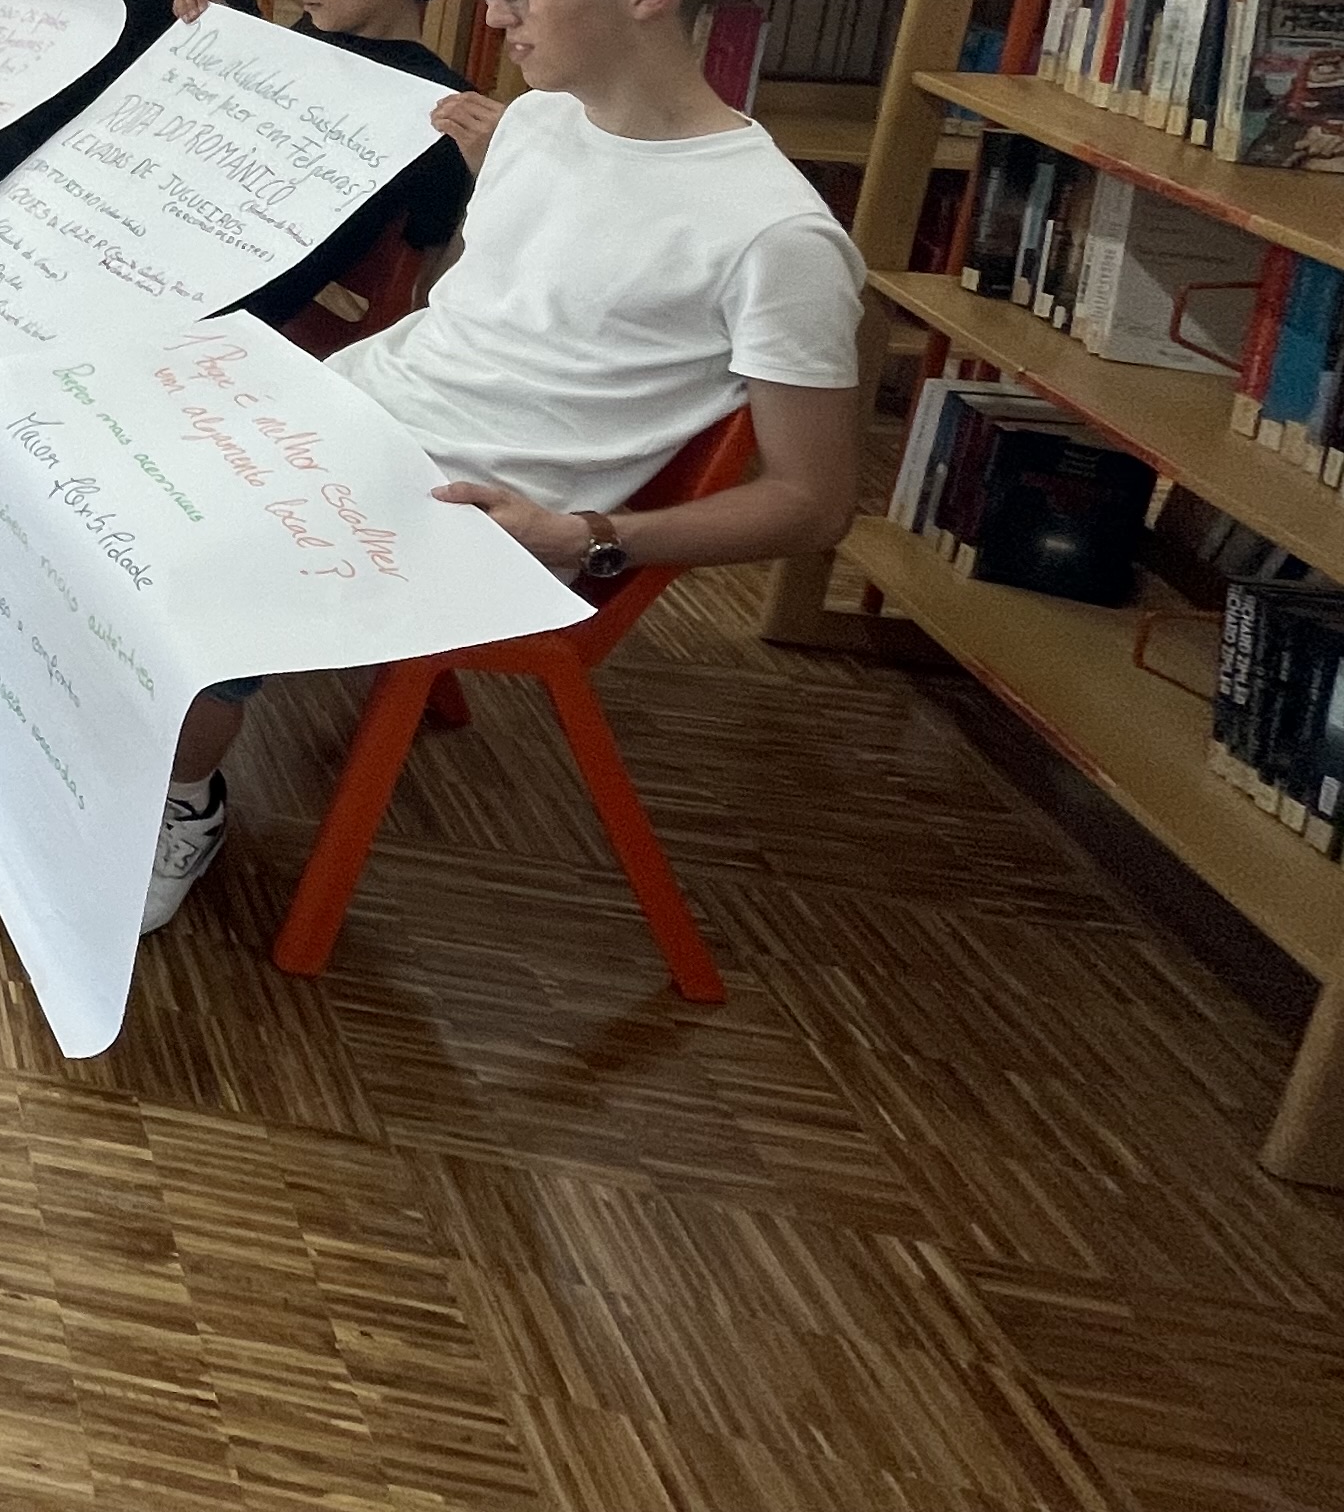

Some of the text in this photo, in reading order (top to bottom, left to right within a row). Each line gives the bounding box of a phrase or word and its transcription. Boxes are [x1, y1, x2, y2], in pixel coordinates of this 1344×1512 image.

[153, 115, 198, 143] DO
[255, 121, 292, 149] em
[61, 128, 134, 171] LEVADAS
[129, 157, 161, 180] DE
[158, 172, 247, 237] JUGUEIROS
[94, 411, 134, 447] mais
[153, 366, 186, 396] um
[263, 497, 336, 549] local
[5, 410, 66, 471] Maior
[46, 476, 155, 593] flexibilidade
[251, 416, 330, 474] melhor
[319, 482, 410, 583] escolher
[39, 553, 79, 614] mais
